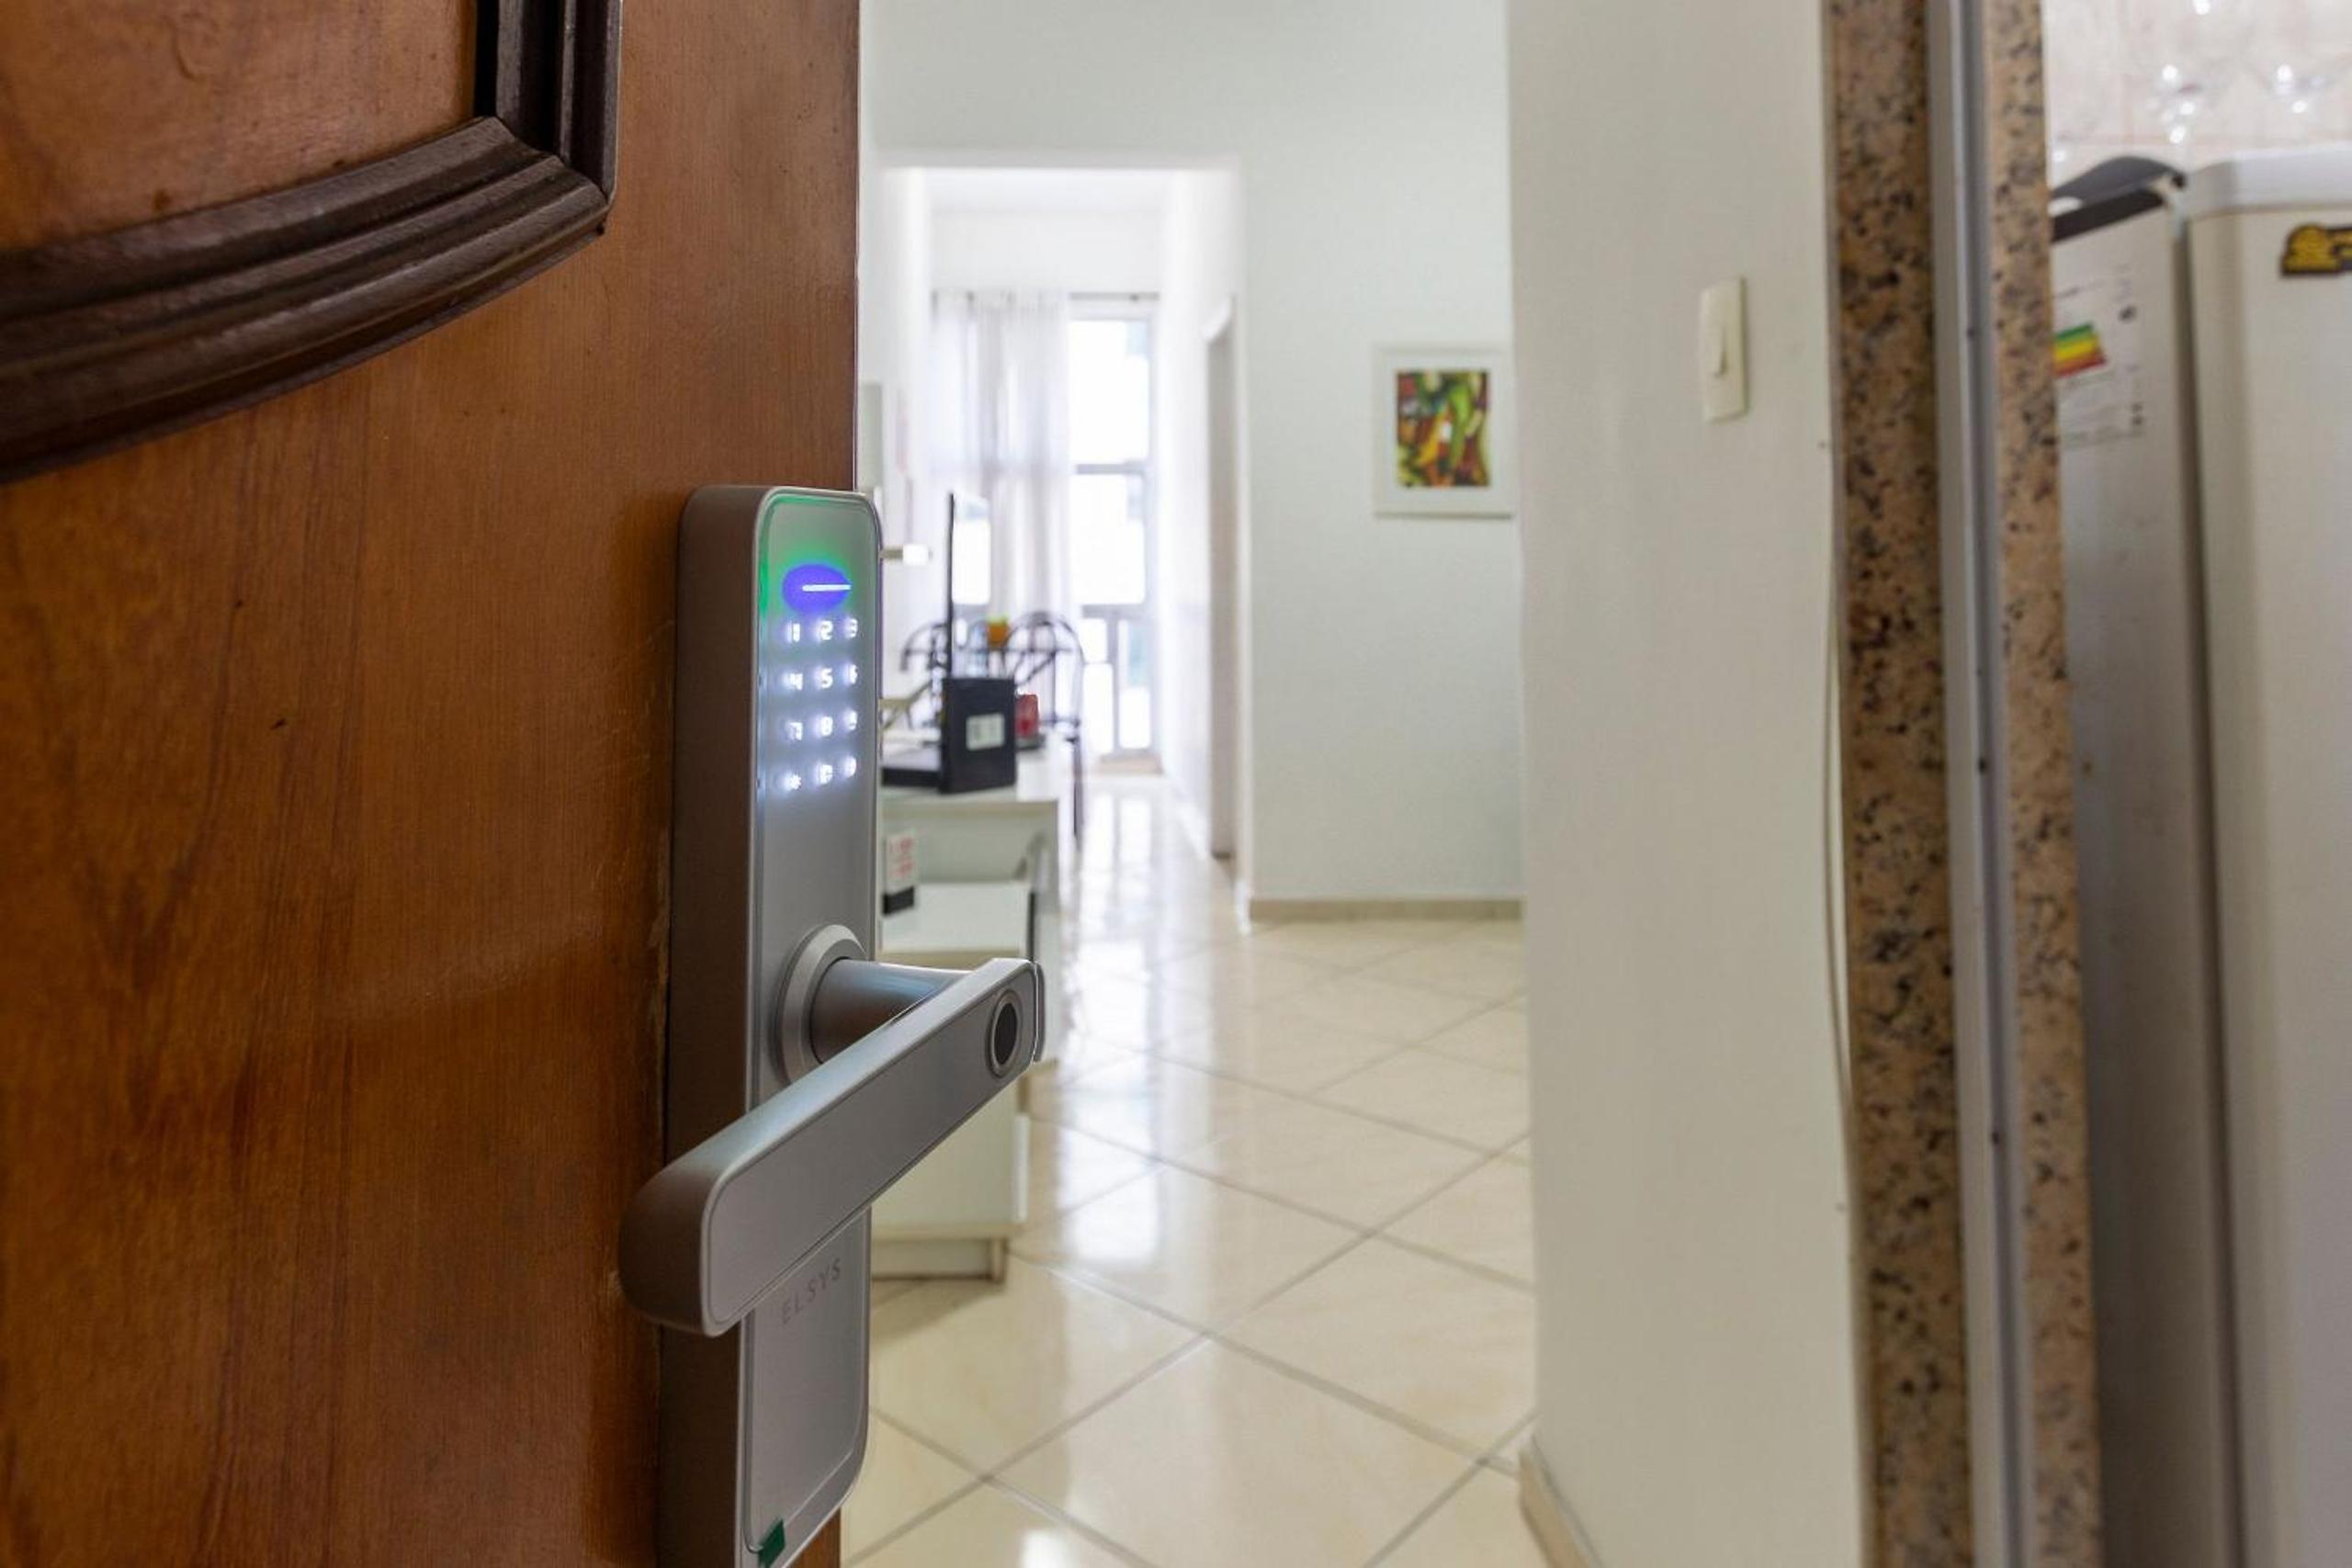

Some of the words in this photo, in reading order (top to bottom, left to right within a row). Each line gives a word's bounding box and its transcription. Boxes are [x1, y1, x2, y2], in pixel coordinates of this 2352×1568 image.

[818, 619, 833, 641] 2
[819, 668, 833, 689] 5
[819, 716, 833, 737] 8
[782, 1257, 841, 1325] ELSYS
